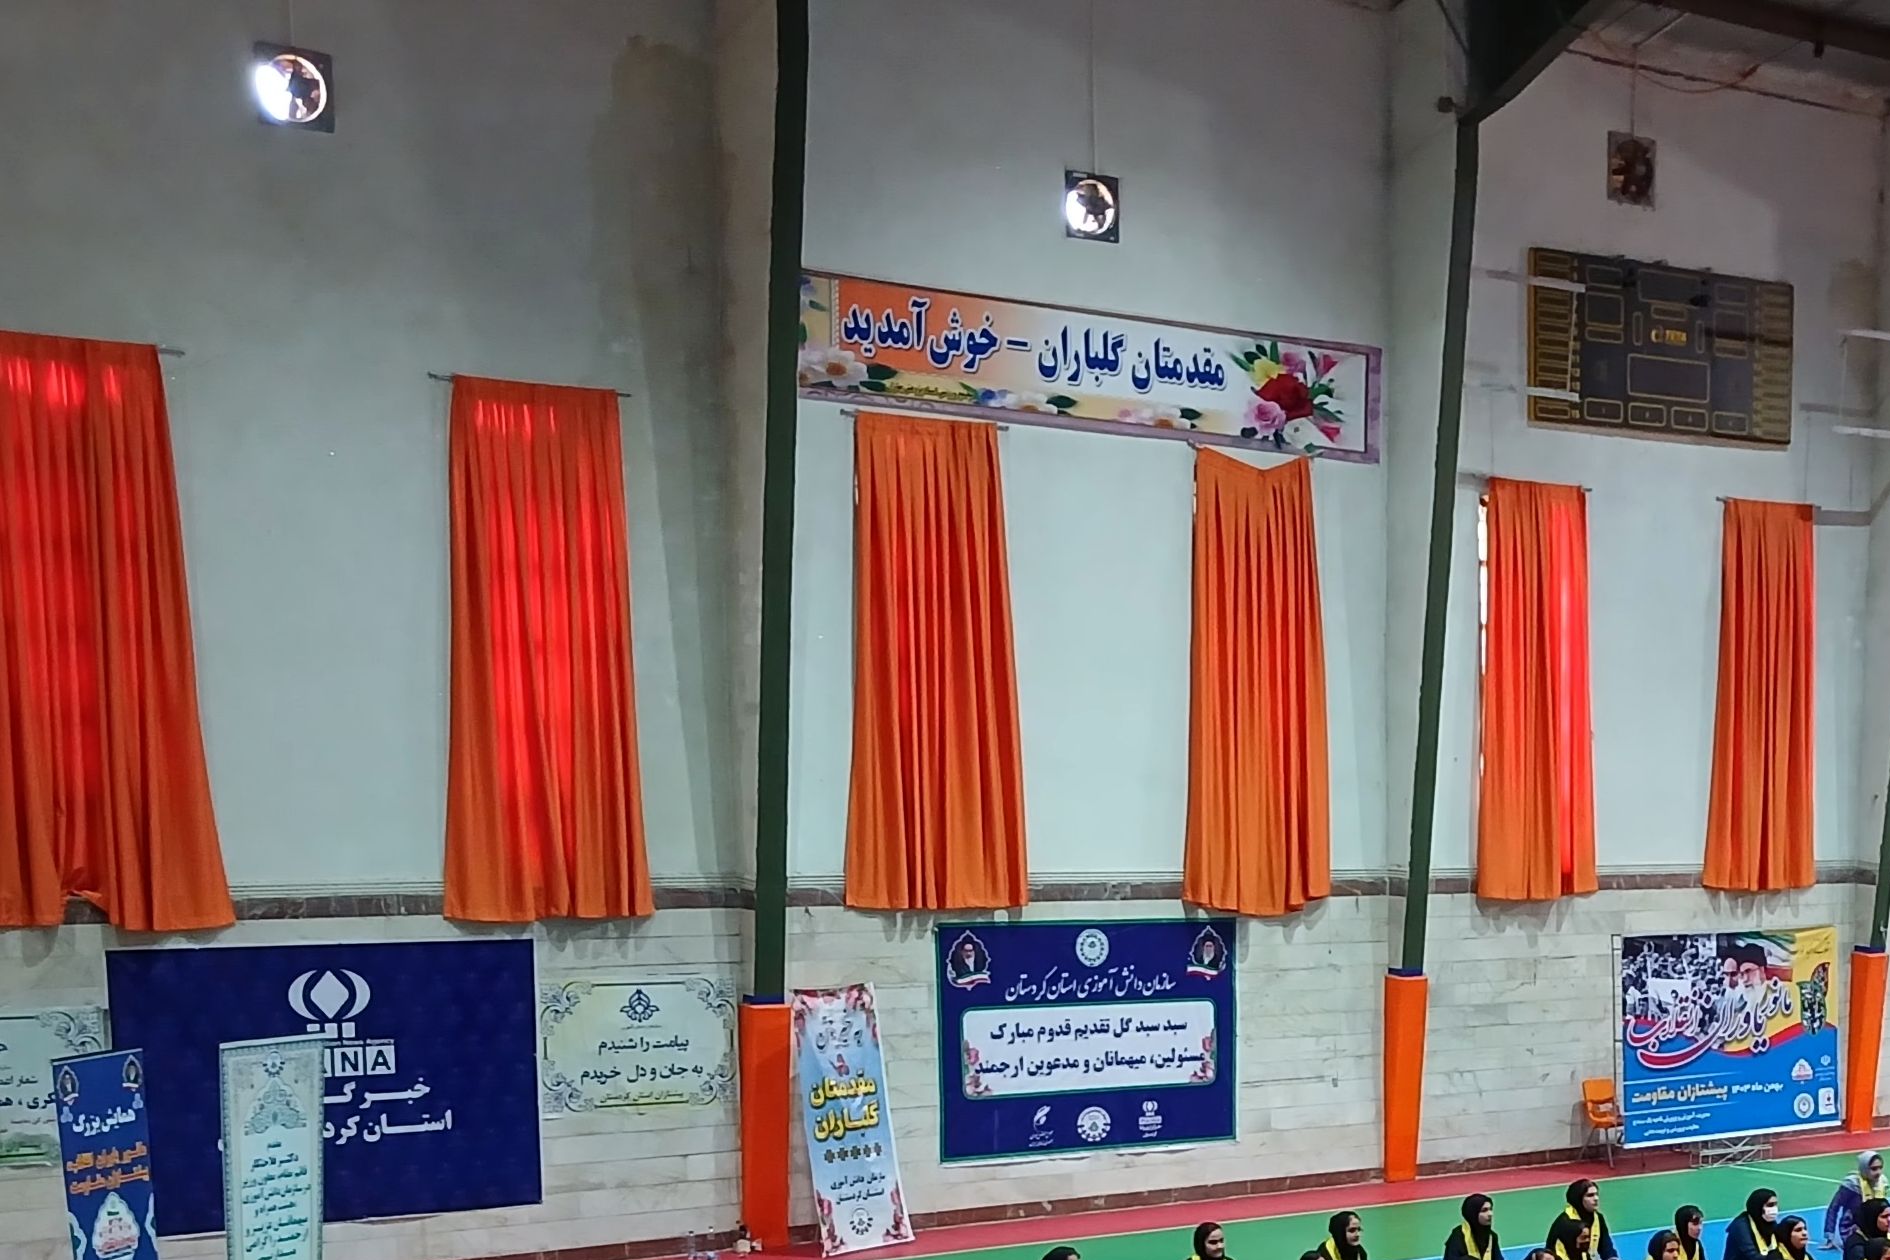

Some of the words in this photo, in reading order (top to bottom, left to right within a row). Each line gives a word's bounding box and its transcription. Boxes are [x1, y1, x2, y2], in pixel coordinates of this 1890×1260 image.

[841, 296, 927, 356] آمدید
[928, 311, 998, 371] خوش
[1036, 324, 1126, 387] گلباران
[1130, 339, 1226, 393] مقدمتان
[1004, 965, 1058, 1002] کردستان
[1046, 971, 1077, 1000] استان
[1077, 966, 1119, 999] آموزی
[1115, 964, 1142, 998] دانش
[1141, 972, 1177, 997] سازمان
[989, 1022, 1034, 1045] مبارک
[1037, 1018, 1071, 1044] قدوم
[1074, 1018, 1110, 1042] تقدیم
[1112, 1016, 1132, 1039] گل
[1135, 1019, 1160, 1038] سبد
[1163, 1018, 1188, 1037] سبد
[598, 1037, 638, 1056] شنیدم
[639, 1036, 650, 1053] را
[659, 1063, 689, 1080] جان
[691, 1064, 704, 1079] به
[973, 1055, 1024, 1079] ارجمند
[1026, 1057, 1080, 1077] مدعوین
[1083, 1058, 1090, 1074] و
[1092, 1049, 1147, 1073] میهمانان
[580, 1065, 621, 1086] خریدم
[626, 1064, 647, 1084] دل
[649, 1066, 657, 1082] و
[809, 1070, 877, 1108] مقدمتان
[1631, 1085, 1676, 1106] مقاومت
[1677, 1080, 1729, 1103] پیشتازان
[72, 1113, 101, 1137] بزرگ
[101, 1106, 136, 1133] همایش
[363, 1108, 453, 1143] استان
[813, 1099, 880, 1142] گلباران
